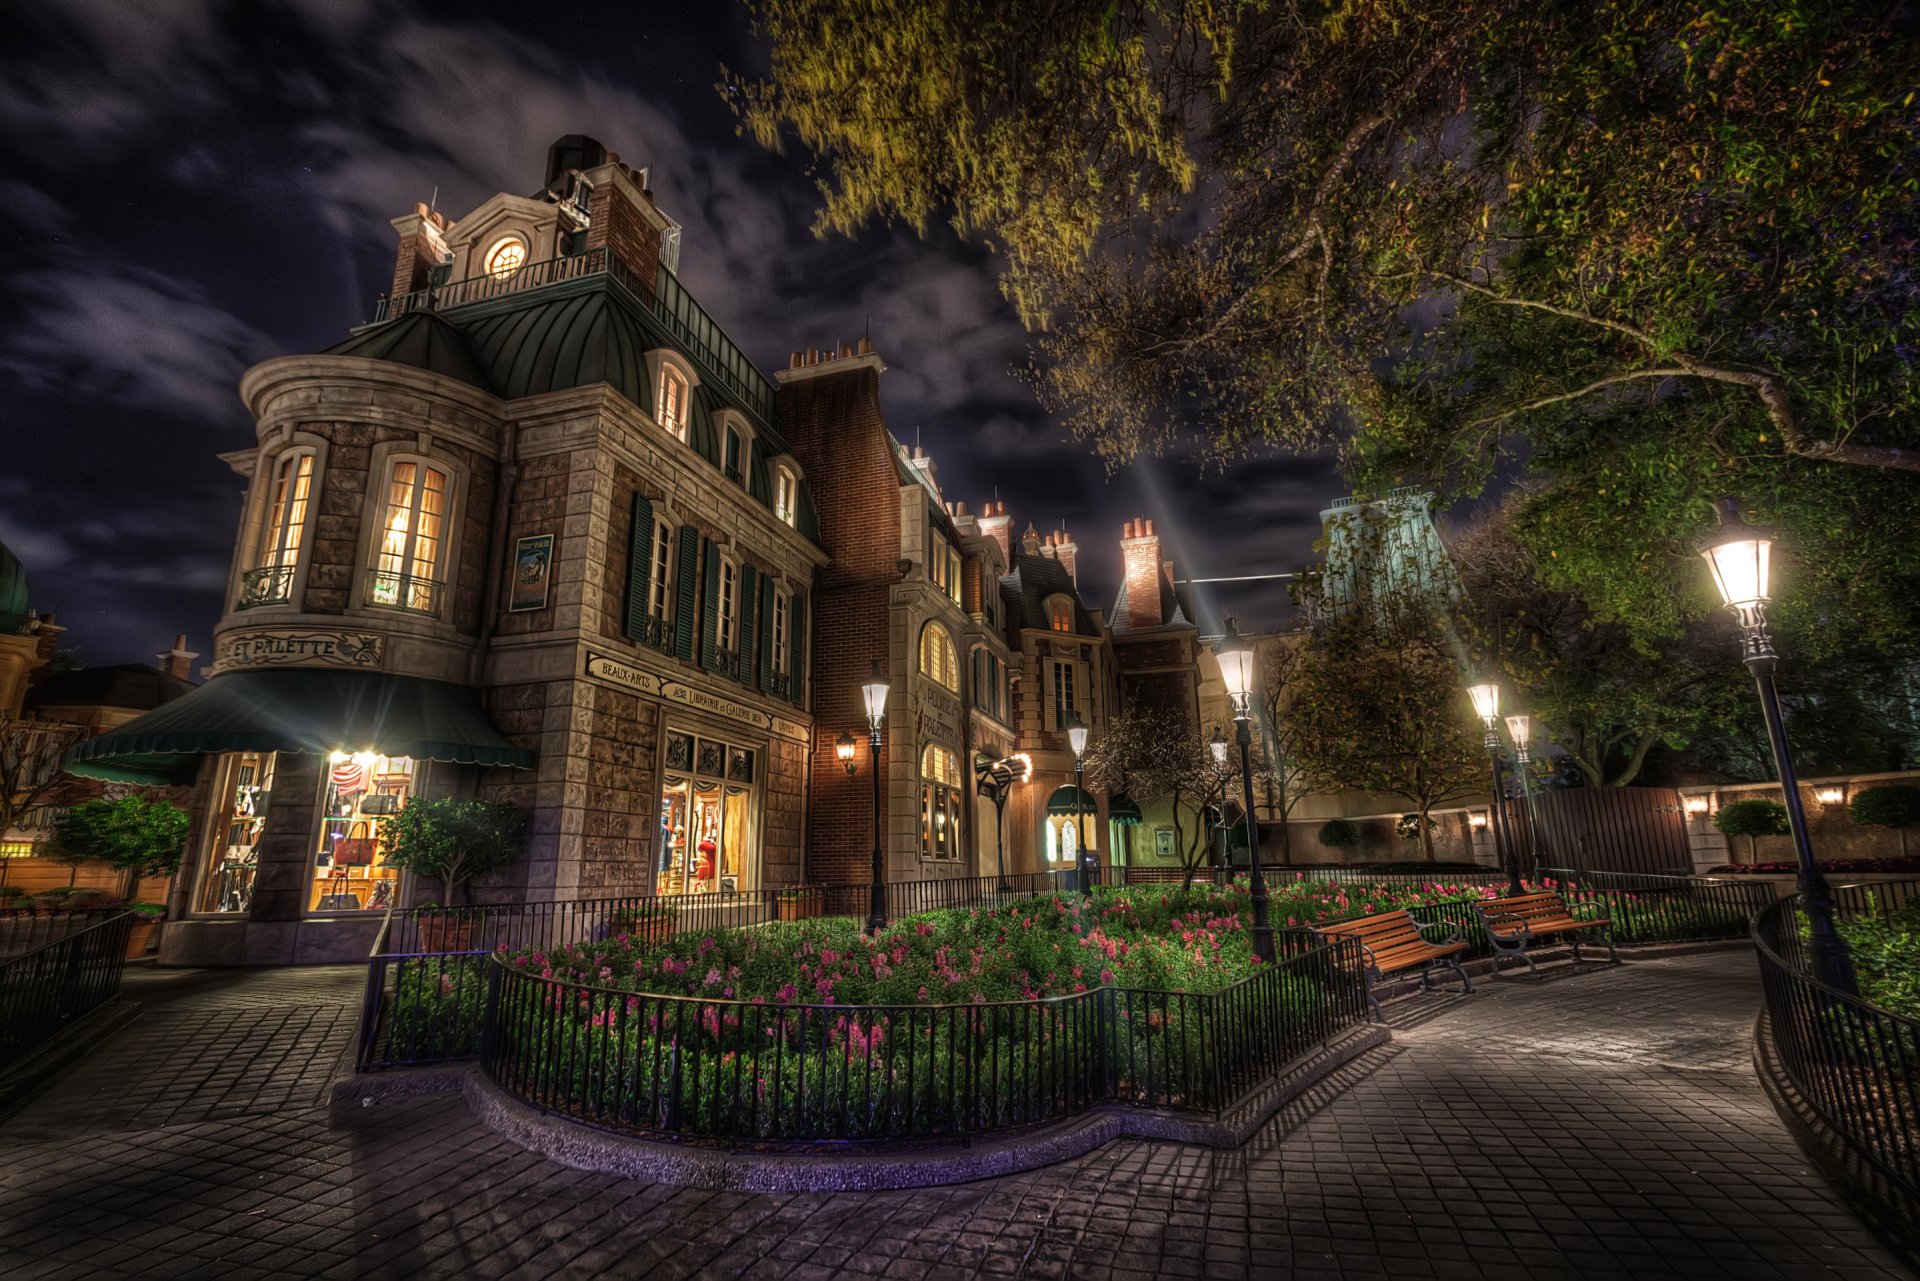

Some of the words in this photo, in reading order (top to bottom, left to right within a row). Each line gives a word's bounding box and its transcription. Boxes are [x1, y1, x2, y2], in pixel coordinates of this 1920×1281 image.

[234, 642, 251, 657] ET
[253, 639, 335, 655] PALETTE
[689, 690, 720, 710] LIBRAIRIE
[923, 713, 955, 744] PALETTE
